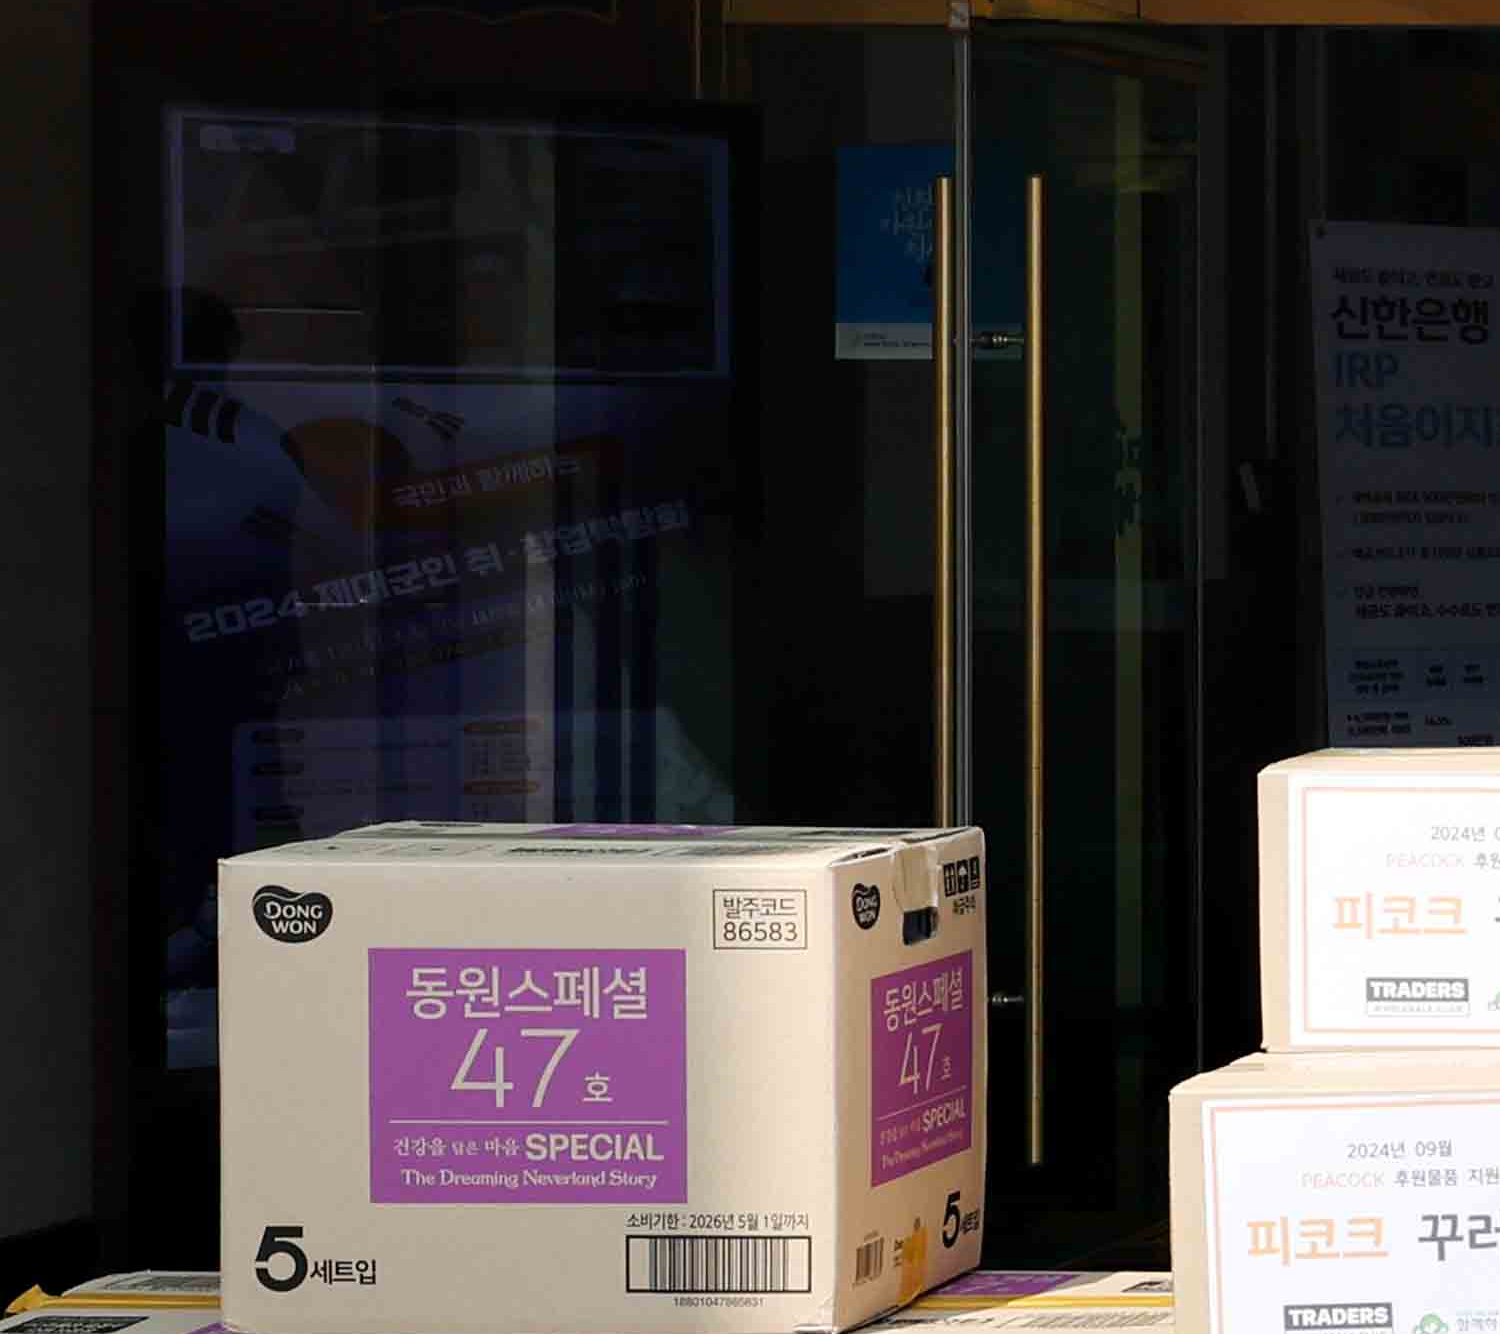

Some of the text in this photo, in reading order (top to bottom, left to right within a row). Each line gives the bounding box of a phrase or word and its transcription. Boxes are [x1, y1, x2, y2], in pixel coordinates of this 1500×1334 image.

[1331, 294, 1490, 346] 신한은행
[1335, 352, 1400, 389] IRP
[263, 900, 324, 920] DONG
[271, 917, 318, 935] WON
[722, 896, 797, 920] 발주코드
[1332, 890, 1468, 940] 피코크
[722, 920, 798, 942] 86583
[405, 965, 649, 1020] 동원스페셜
[883, 967, 964, 1033] 동원스페셜
[448, 1026, 614, 1108] 47 호
[899, 1023, 943, 1096] 47
[921, 1097, 967, 1135] SPECIAL
[393, 1136, 447, 1157] 건강을
[484, 1136, 520, 1157] 마음
[525, 1130, 665, 1161] SPECIAL
[401, 1168, 657, 1190] The Dreaming Neverland Story
[689, 1212, 734, 1230] 2026년
[737, 1212, 760, 1230] 5월
[763, 1211, 809, 1230] 1일까지
